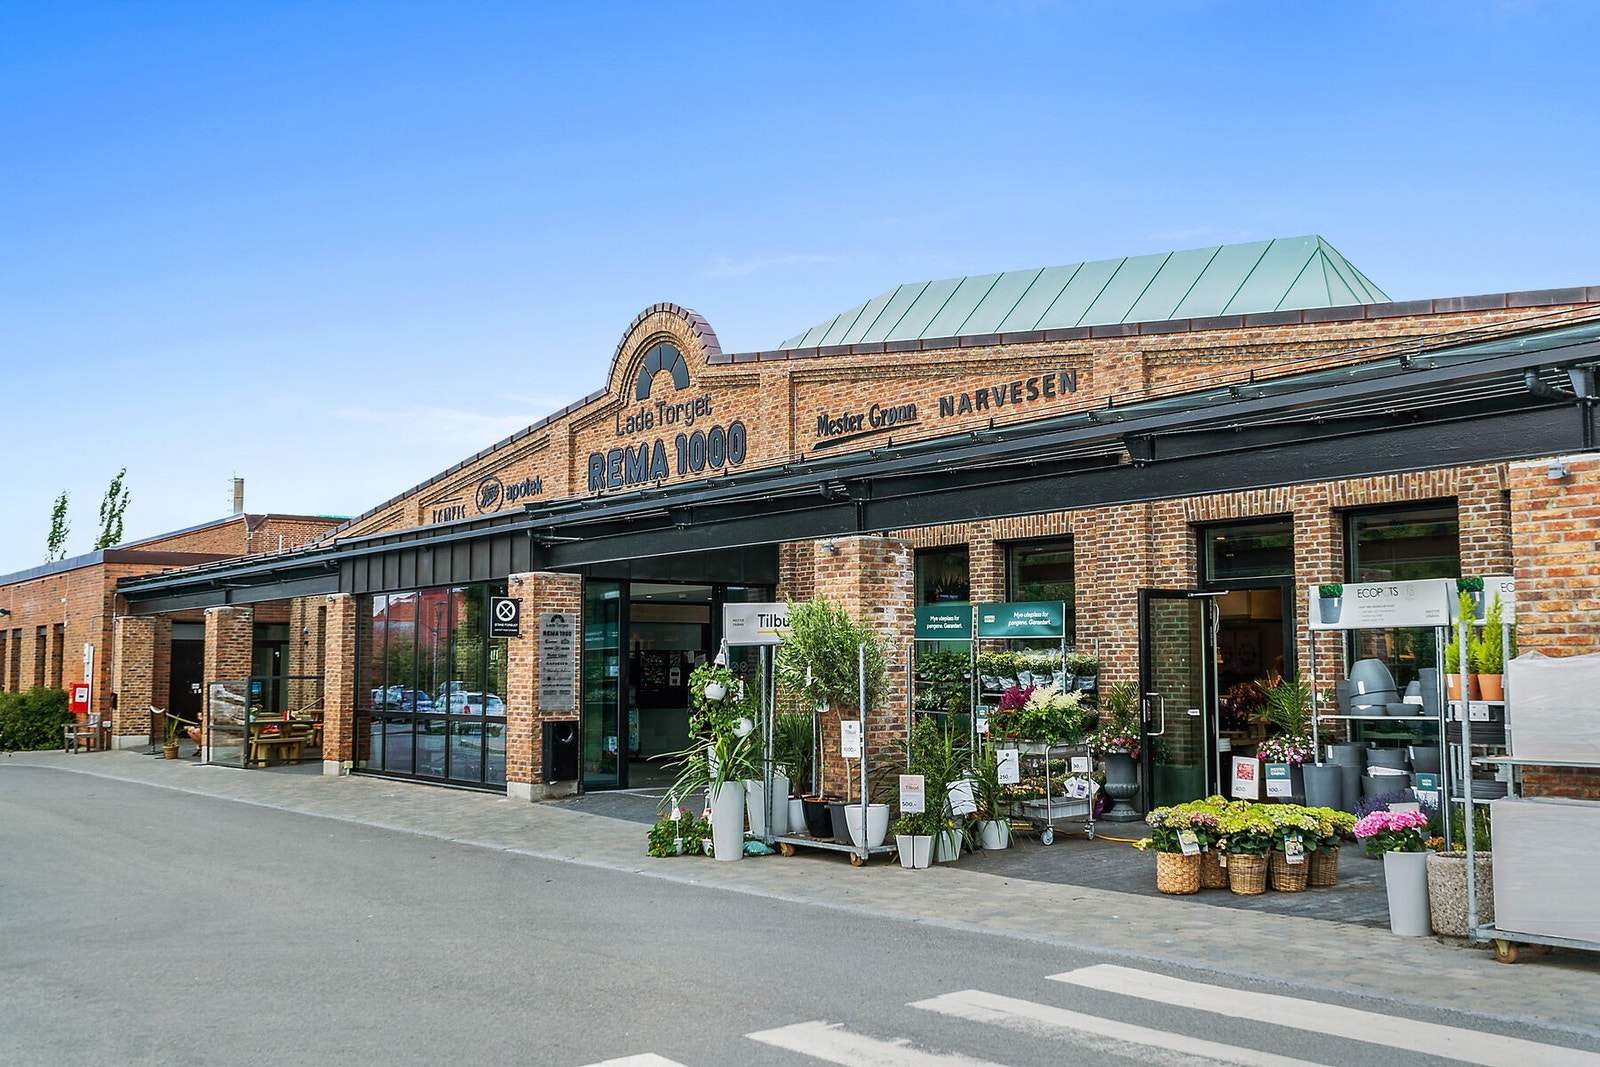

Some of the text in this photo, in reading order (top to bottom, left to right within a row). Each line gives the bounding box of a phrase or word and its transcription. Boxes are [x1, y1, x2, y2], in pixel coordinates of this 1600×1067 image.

[939, 371, 1077, 418] NARVESEN
[615, 393, 712, 436] Lade Torget
[816, 402, 917, 438] Mester Grønn
[588, 420, 747, 492] REMA 1000
[506, 475, 543, 503] apotek
[1500, 582, 1516, 593] EC
[757, 613, 791, 628] Tilbu
